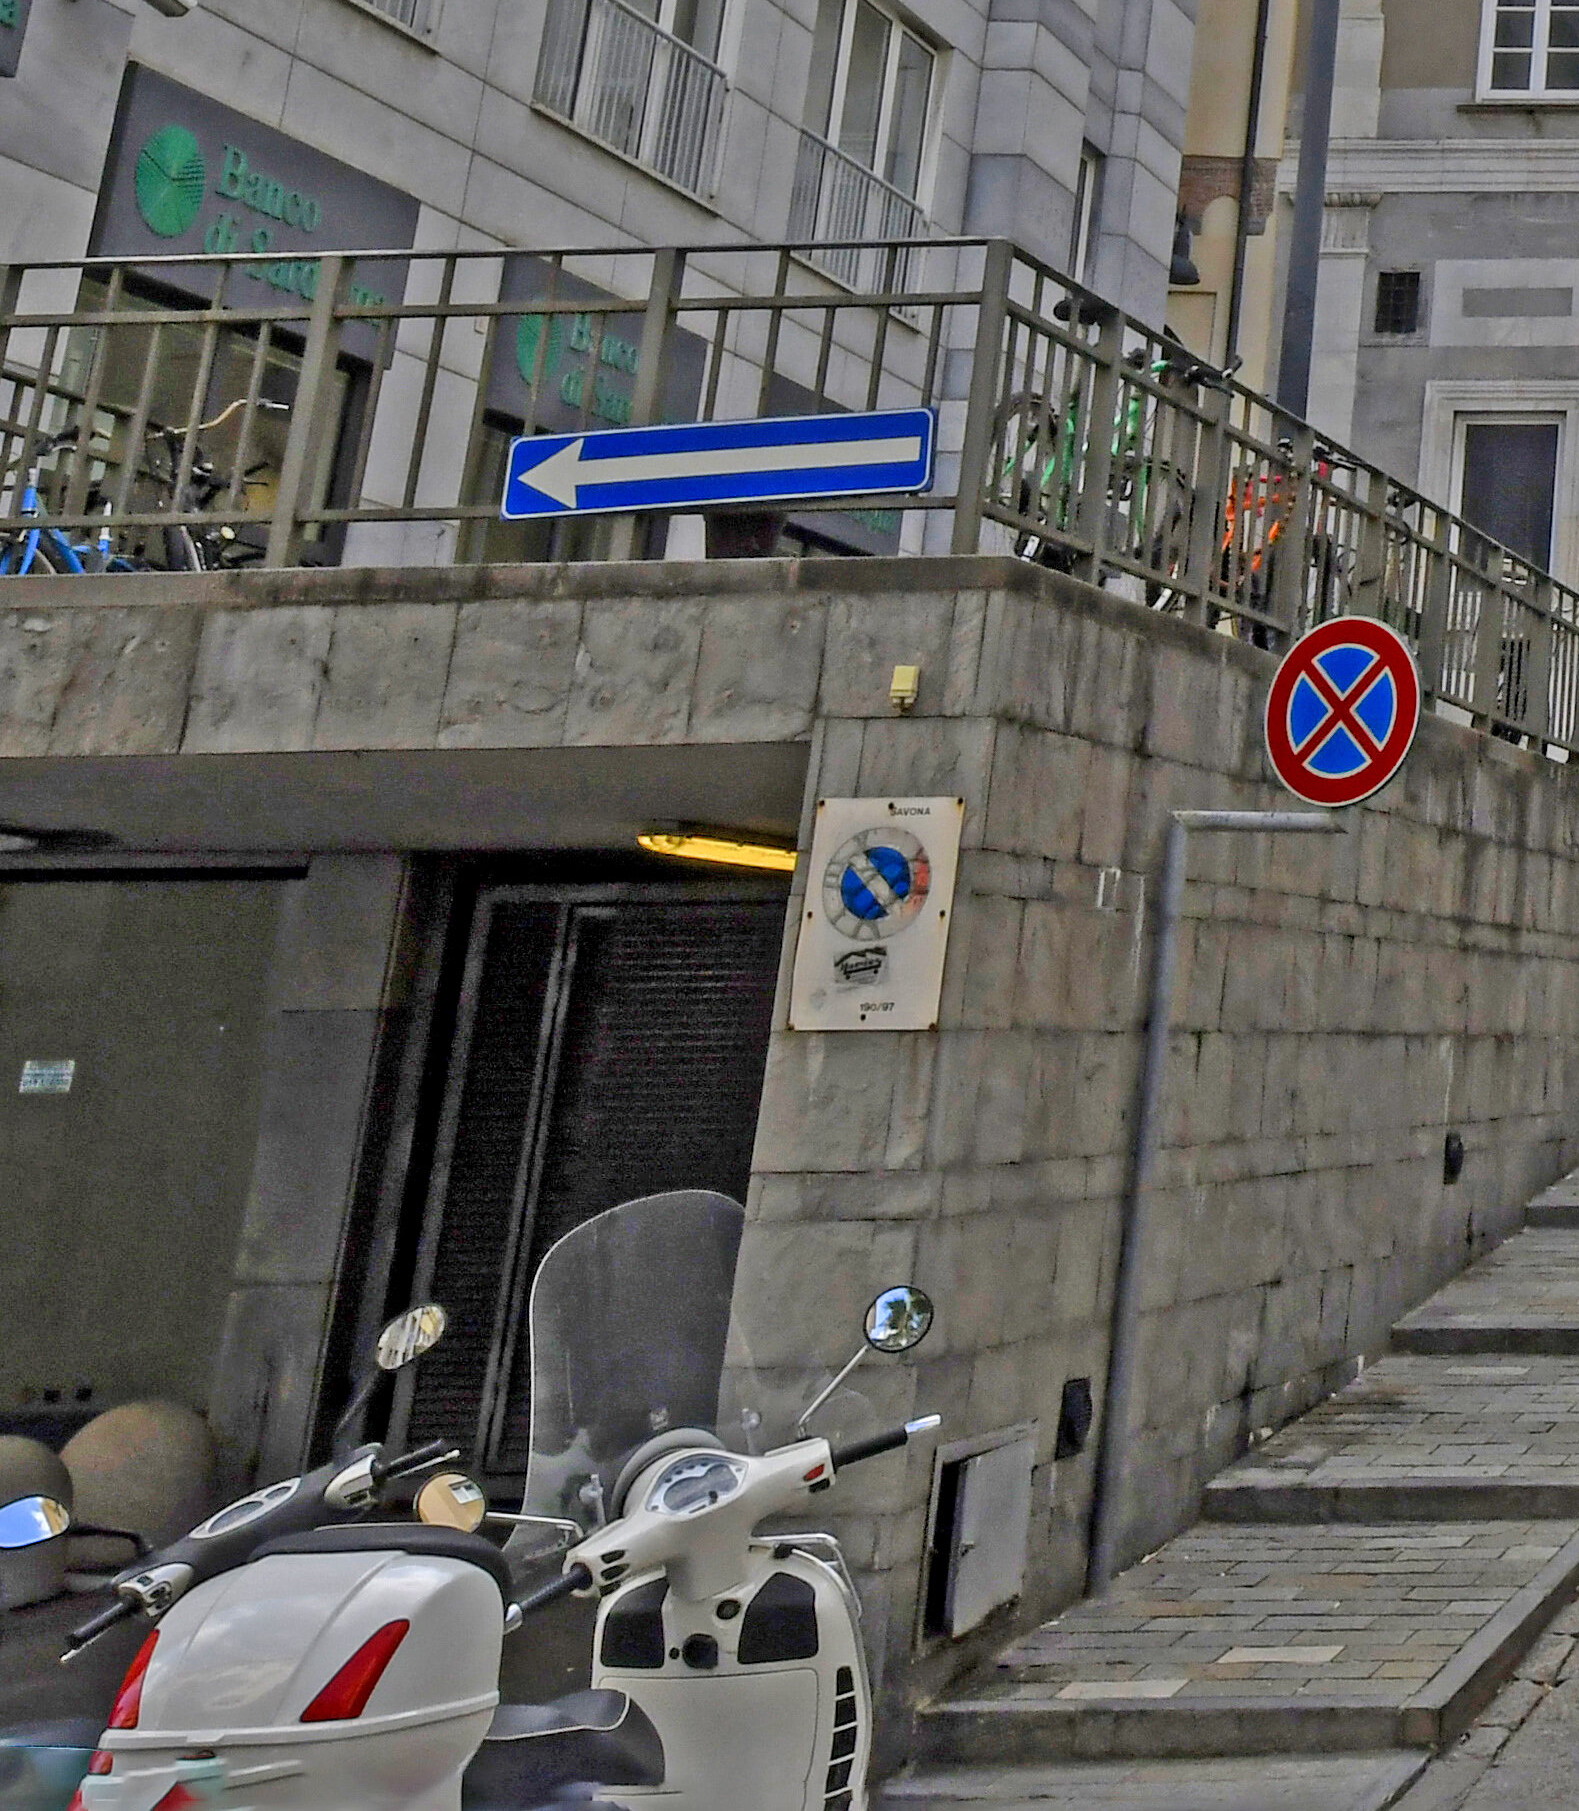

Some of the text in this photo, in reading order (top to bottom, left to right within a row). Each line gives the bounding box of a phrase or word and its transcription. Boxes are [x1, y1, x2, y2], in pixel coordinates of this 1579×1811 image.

[215, 142, 322, 233] Banco
[889, 806, 931, 817] SAVONA
[859, 1001, 895, 1012] 190/97
